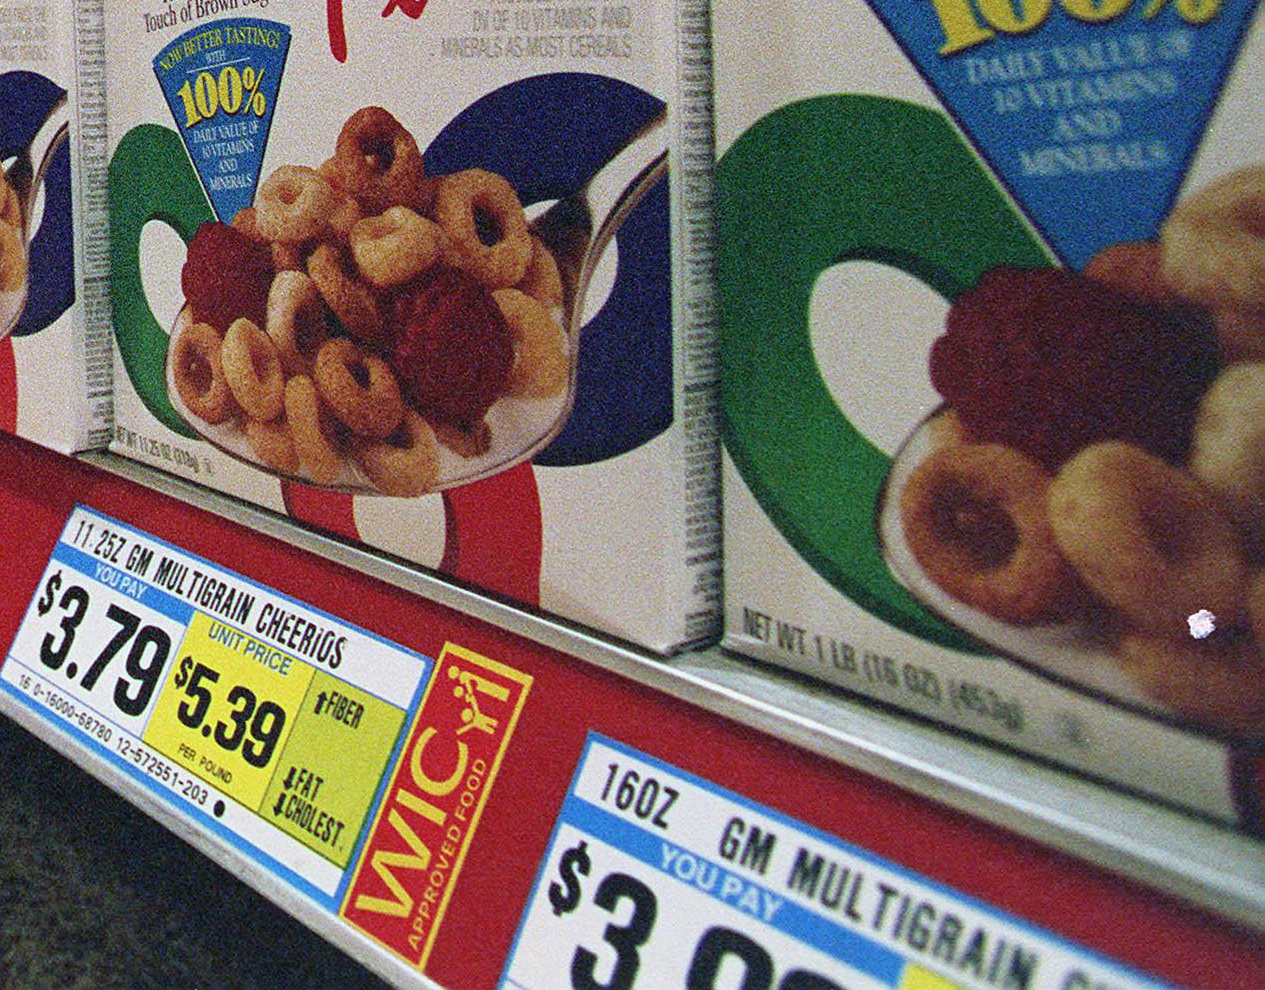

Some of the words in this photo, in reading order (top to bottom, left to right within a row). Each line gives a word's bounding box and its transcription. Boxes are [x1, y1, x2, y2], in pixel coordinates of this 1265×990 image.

[143, 4, 177, 34] Touch
[184, 29, 224, 59] BETTER
[568, 33, 632, 59] CEREALS
[177, 66, 267, 128] 100%
[73, 520, 127, 564] 11.25Z
[125, 543, 155, 577] GM
[152, 555, 254, 626] MULTIGRAIN
[255, 601, 348, 670] CHEERIOS
[94, 562, 120, 588] YOU
[119, 576, 148, 600] PAY
[37, 569, 173, 718] $3.79
[208, 621, 245, 650] UNIT
[244, 639, 293, 676] PRICE
[742, 606, 773, 644] NET
[777, 619, 806, 656] WT
[814, 635, 825, 663] 1
[830, 637, 857, 673] LB
[175, 655, 286, 769] $5.39
[326, 690, 366, 730] FIBER
[117, 736, 209, 806] 12-572551-203
[177, 742, 197, 761] PER
[199, 755, 233, 784] POUND
[292, 767, 324, 801] FAT
[354, 726, 469, 920] WIC
[407, 824, 462, 952] APPROVED
[455, 758, 487, 823] FOOD
[660, 843, 722, 891] YOU
[722, 870, 785, 924] PAY
[717, 816, 779, 877] GM
[788, 846, 1040, 990] MULTIGRAIN
